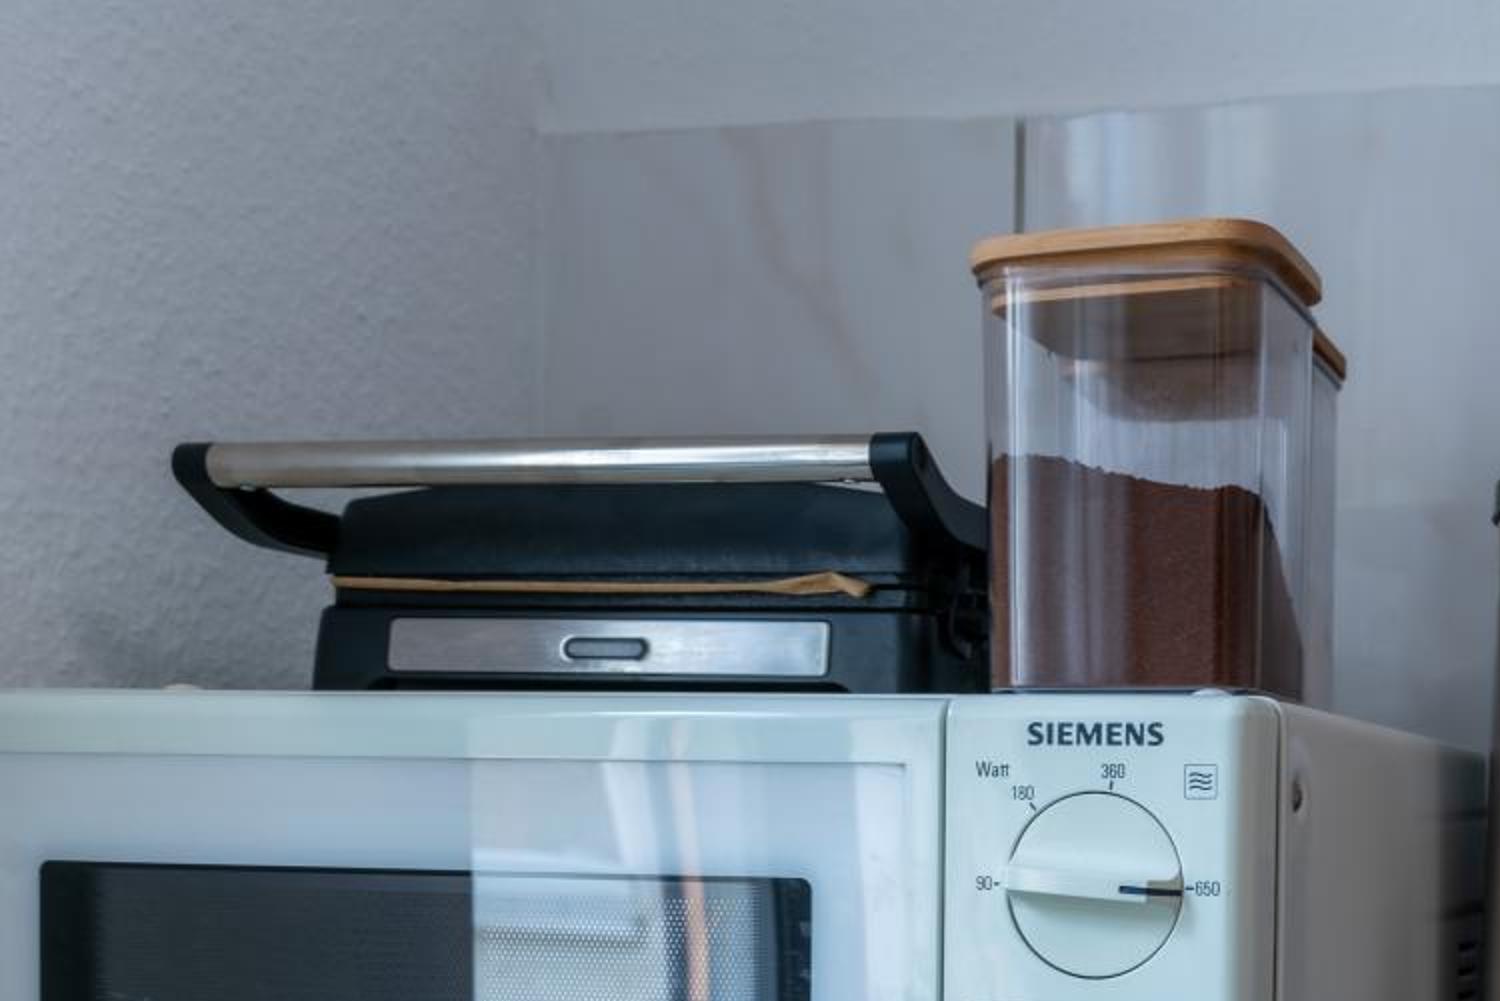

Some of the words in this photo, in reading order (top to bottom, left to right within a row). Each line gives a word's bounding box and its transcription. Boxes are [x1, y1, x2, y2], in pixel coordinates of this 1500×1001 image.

[1027, 722, 1164, 747] SIEMENS
[975, 761, 1009, 777] Watt
[1101, 763, 1125, 779] 360
[1012, 785, 1035, 801] 180
[976, 876, 992, 891] 90
[1195, 881, 1220, 896] 650
